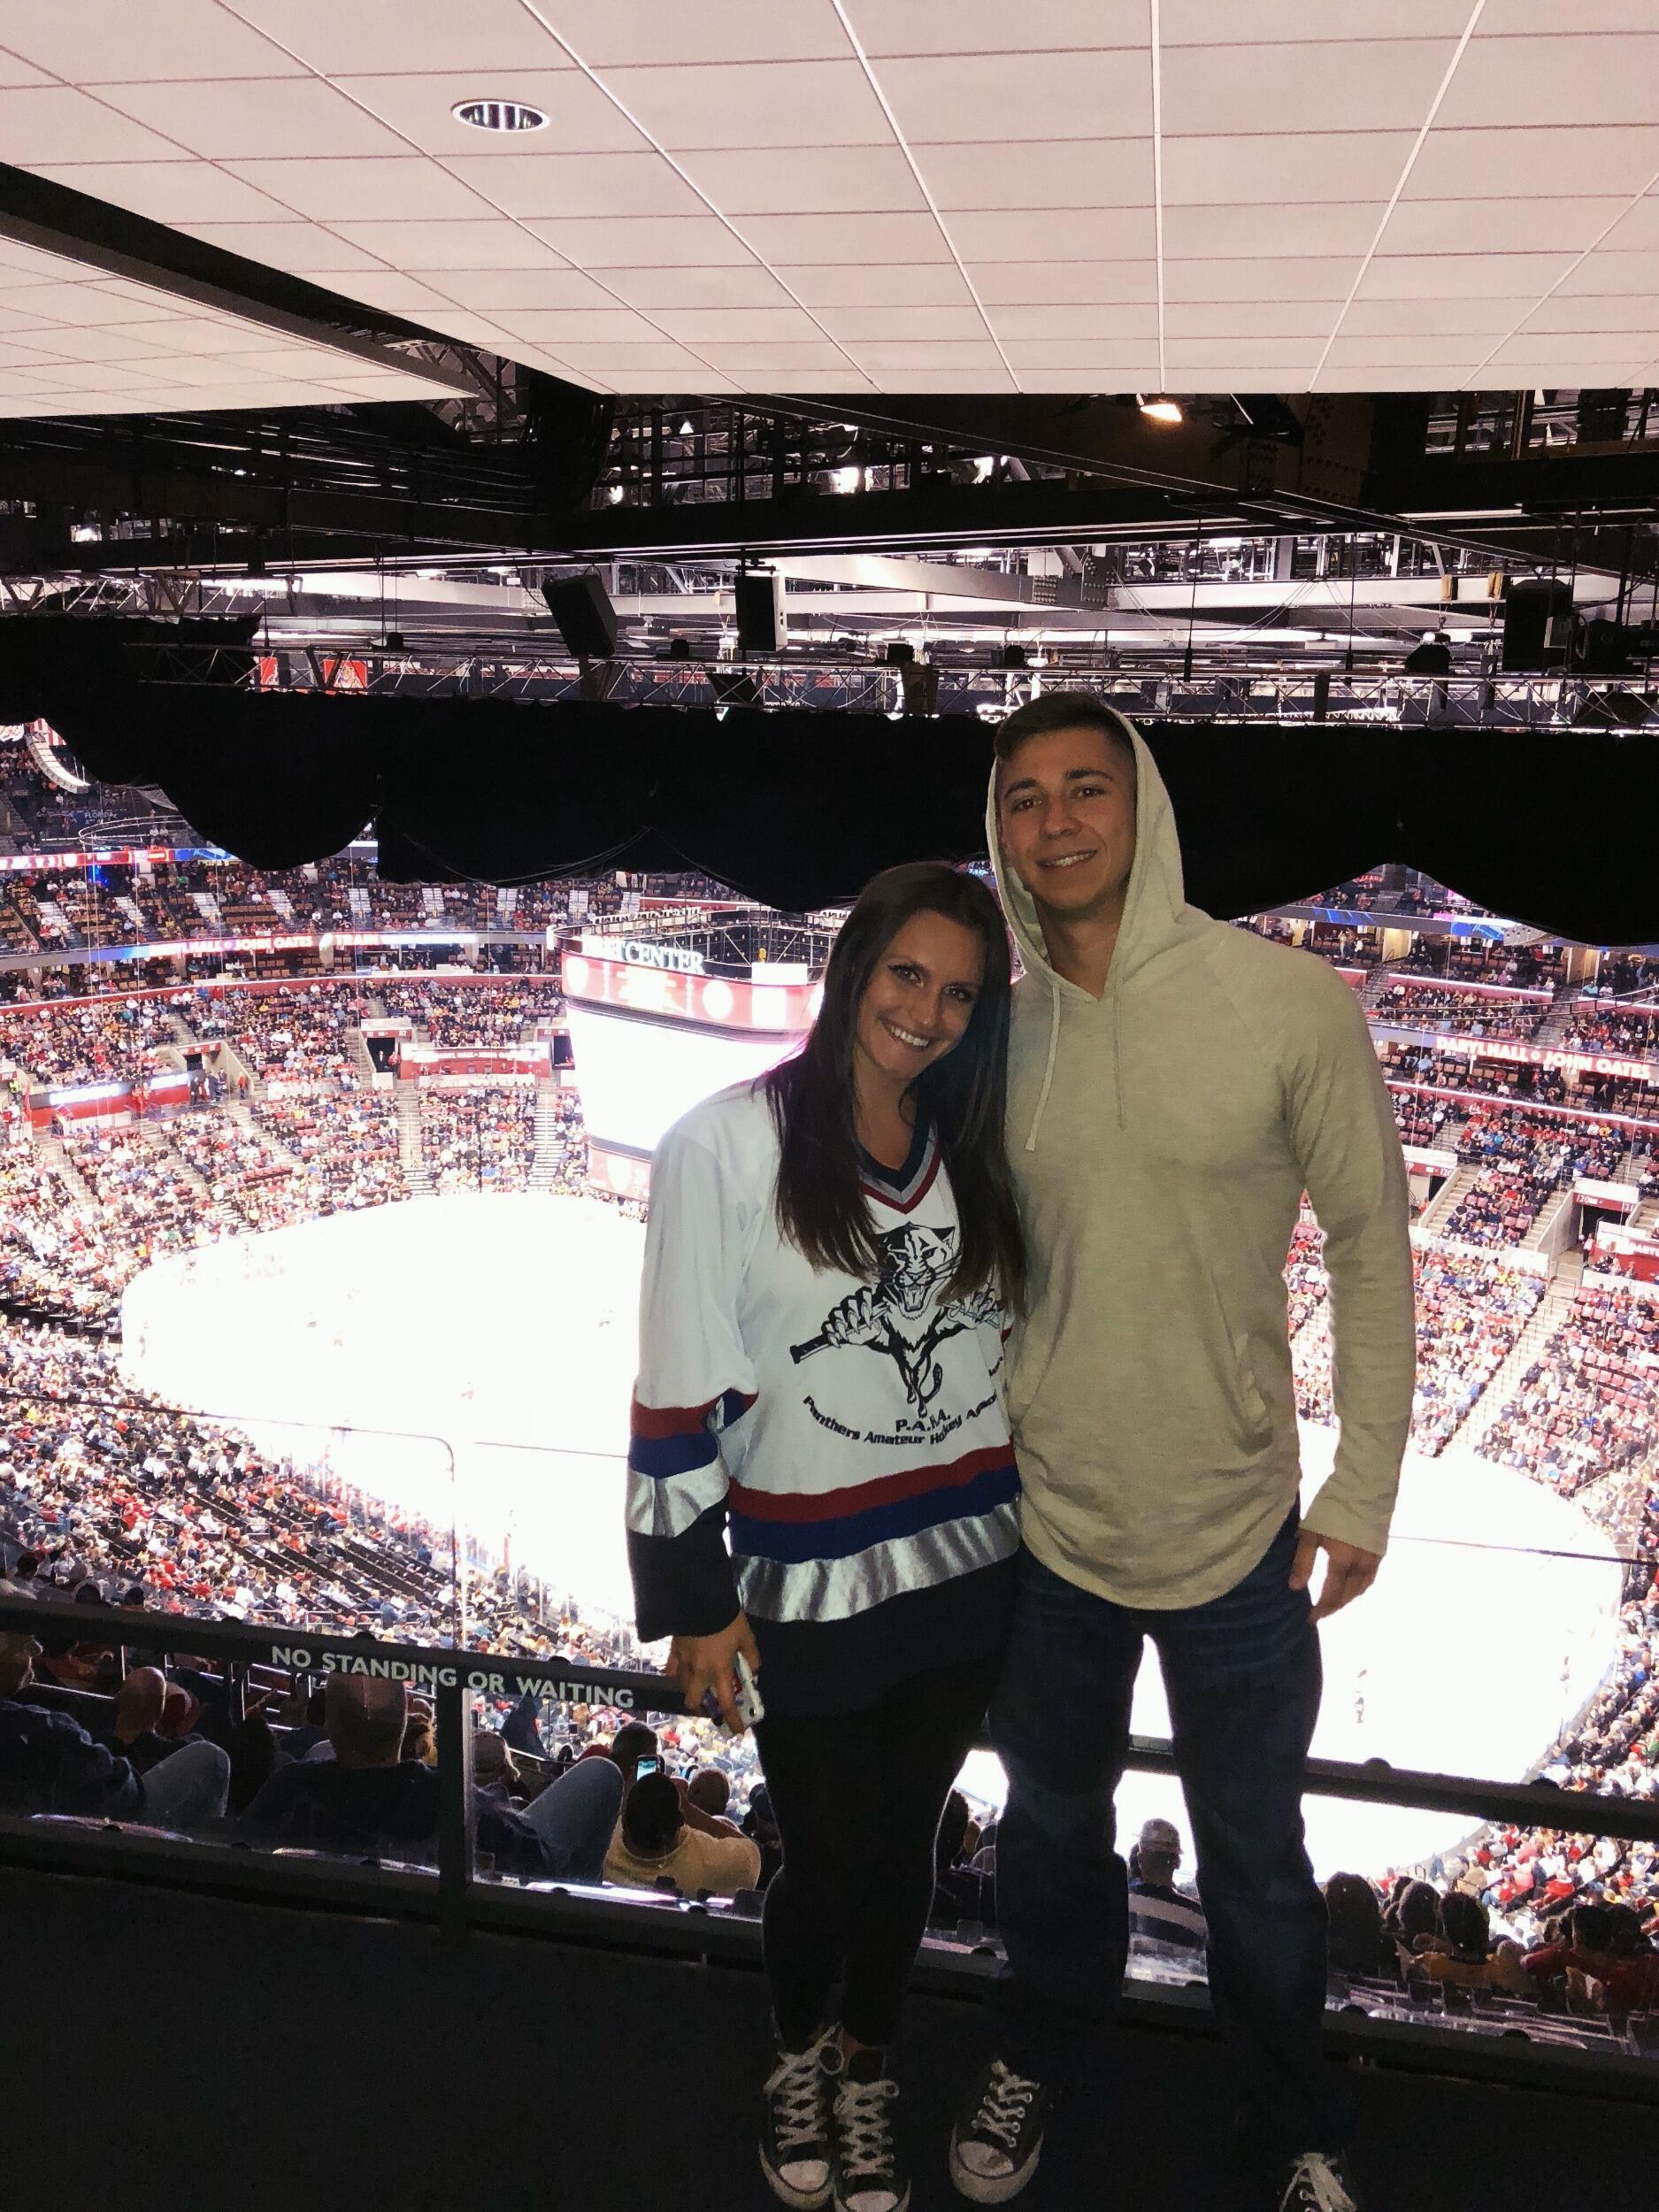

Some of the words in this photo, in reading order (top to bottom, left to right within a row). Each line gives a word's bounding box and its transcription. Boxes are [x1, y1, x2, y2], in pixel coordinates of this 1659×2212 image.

[625, 941, 706, 975] CENTER
[1436, 1036, 1486, 1056] DARYL
[1486, 1043, 1529, 1062] HALL
[1545, 1051, 1593, 1071] JOHN
[1596, 1058, 1651, 1079] OATES
[1576, 1194, 1589, 1204] 120
[803, 1395, 861, 1440] Panthers
[864, 1431, 926, 1445] Amateur
[271, 1646, 311, 1668] NO
[322, 1652, 457, 1687] STANDING
[467, 1671, 506, 1694] OR
[516, 1676, 634, 1709] WAITING
